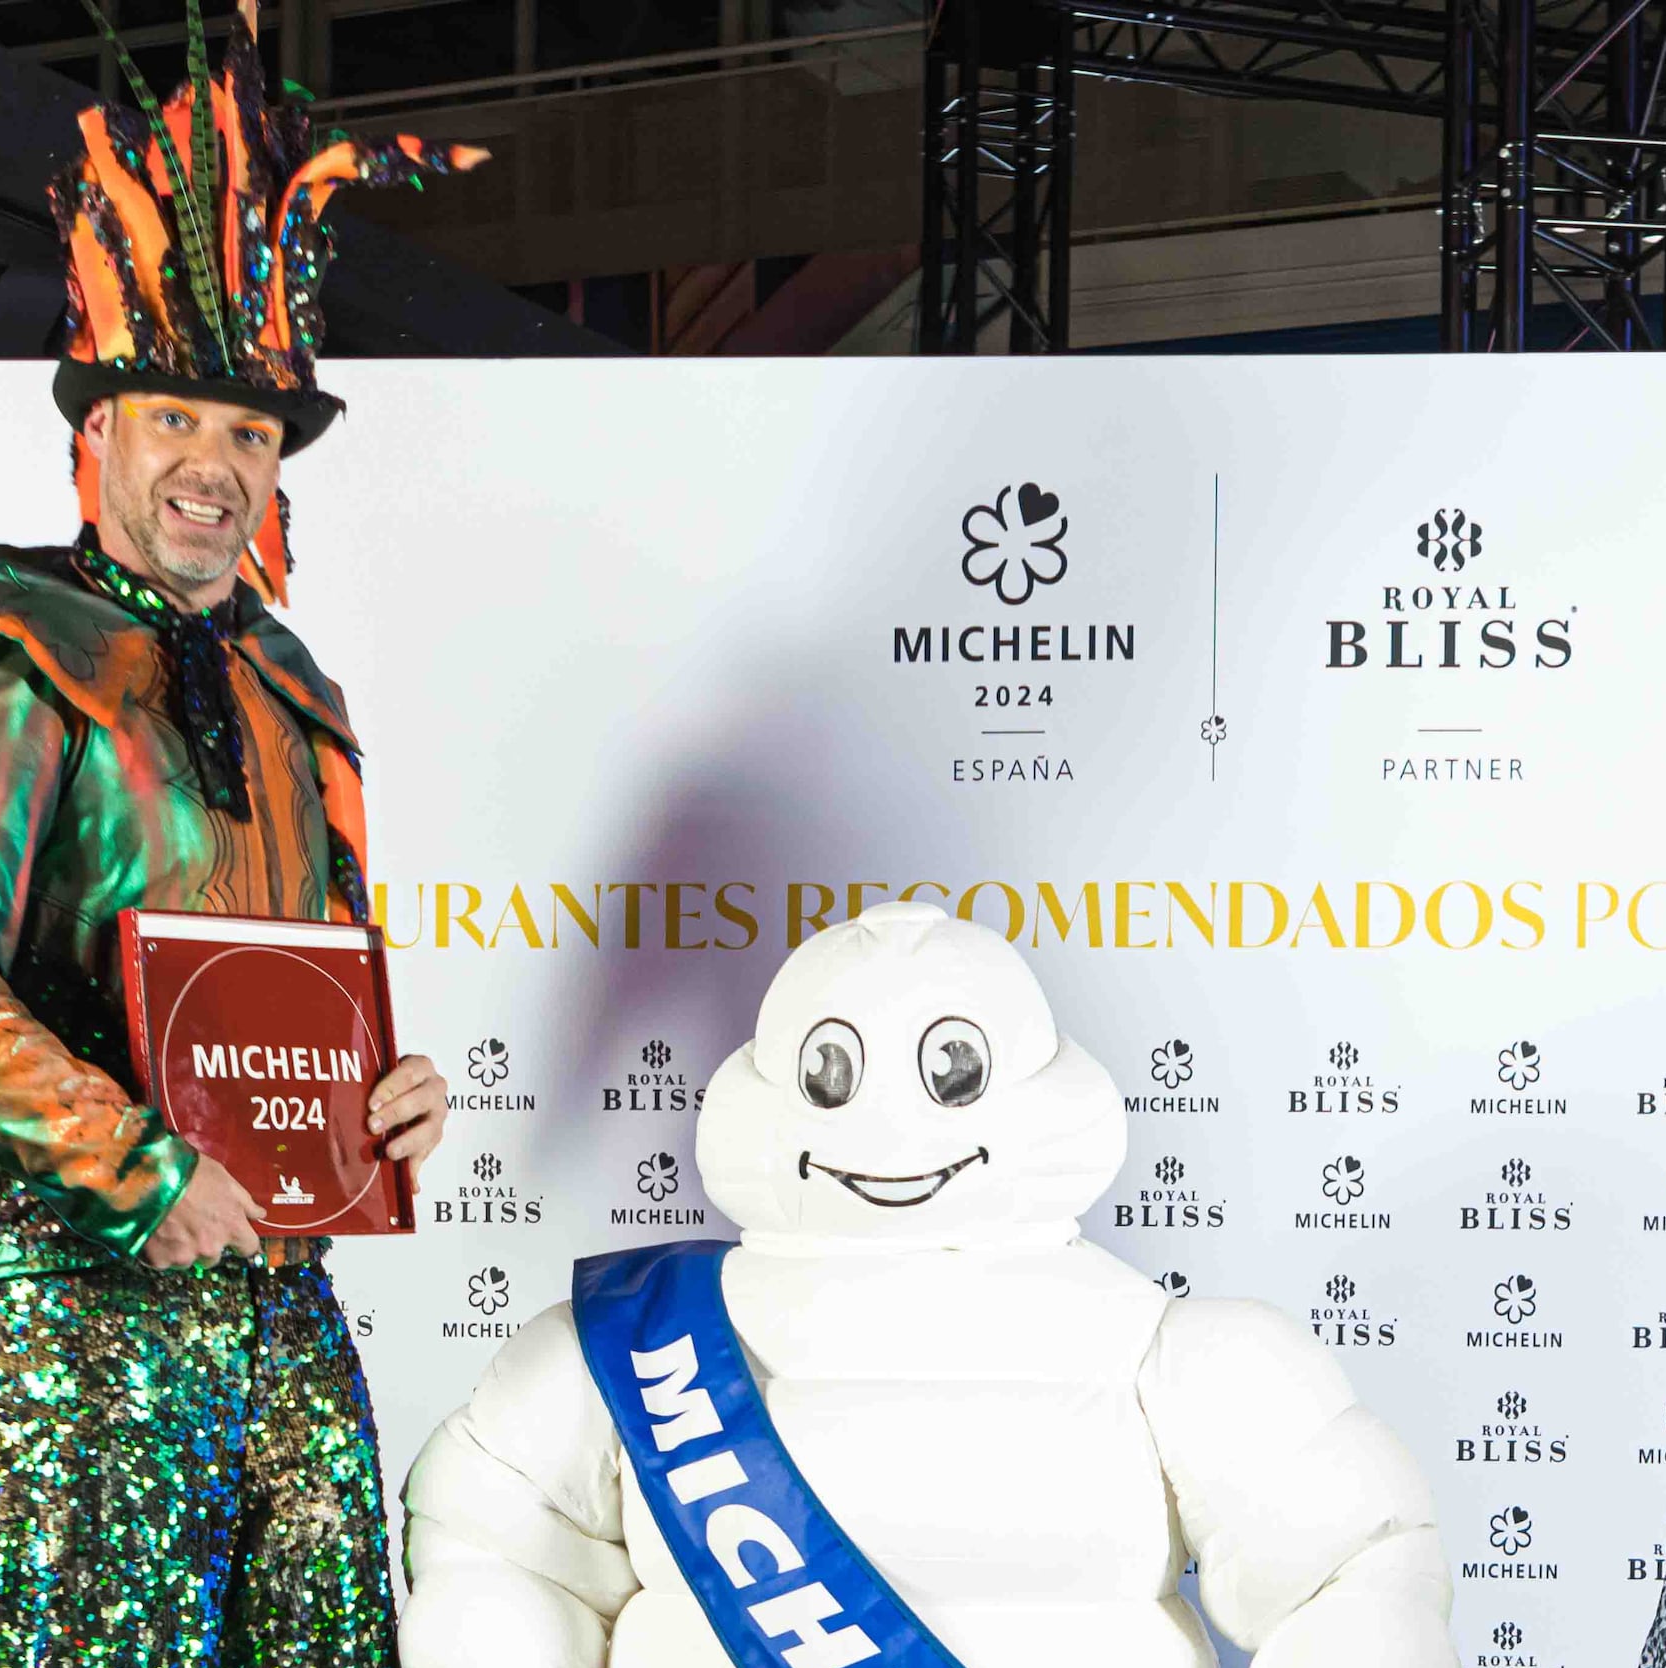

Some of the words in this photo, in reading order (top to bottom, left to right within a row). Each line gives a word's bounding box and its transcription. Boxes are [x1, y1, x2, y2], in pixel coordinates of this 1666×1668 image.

[1382, 586, 1517, 612] ROYAL
[893, 624, 1135, 664] MICHELIN
[1325, 619, 1574, 669] BLISS
[974, 685, 1054, 708] 2024
[952, 755, 1075, 782] ESPAÑA
[1382, 758, 1525, 782] PARTNER
[786, 880, 1545, 950] ROMENDADOS
[191, 1043, 363, 1083] MICHELIN
[627, 1074, 688, 1087] ROYAL
[1313, 1076, 1374, 1088] ROYAL
[444, 1094, 535, 1111] MICHELIN
[1124, 1096, 1219, 1113] MICHELIN
[1288, 1091, 1398, 1113] BLISS
[1471, 1098, 1566, 1115] MICHELIN
[250, 1095, 327, 1131] 2024
[458, 1185, 517, 1199] ROYAL
[1138, 1188, 1200, 1203] ROYAL
[1486, 1192, 1546, 1205] ROYAL
[434, 1199, 541, 1224] BLISS
[611, 1208, 705, 1225] MICHELIN
[1113, 1204, 1225, 1228] BLISS
[1460, 1207, 1571, 1231] BLISS
[1295, 1213, 1390, 1229] MICHELIN
[1310, 1308, 1370, 1321] ROYAL
[442, 1322, 521, 1338] MICHEL
[1467, 1331, 1562, 1348] MICHELIN
[1482, 1423, 1541, 1437] ROYAL
[1456, 1438, 1567, 1463] BLISS
[1463, 1562, 1557, 1579] MICHELIN
[1477, 1654, 1537, 1668] ROYAL
